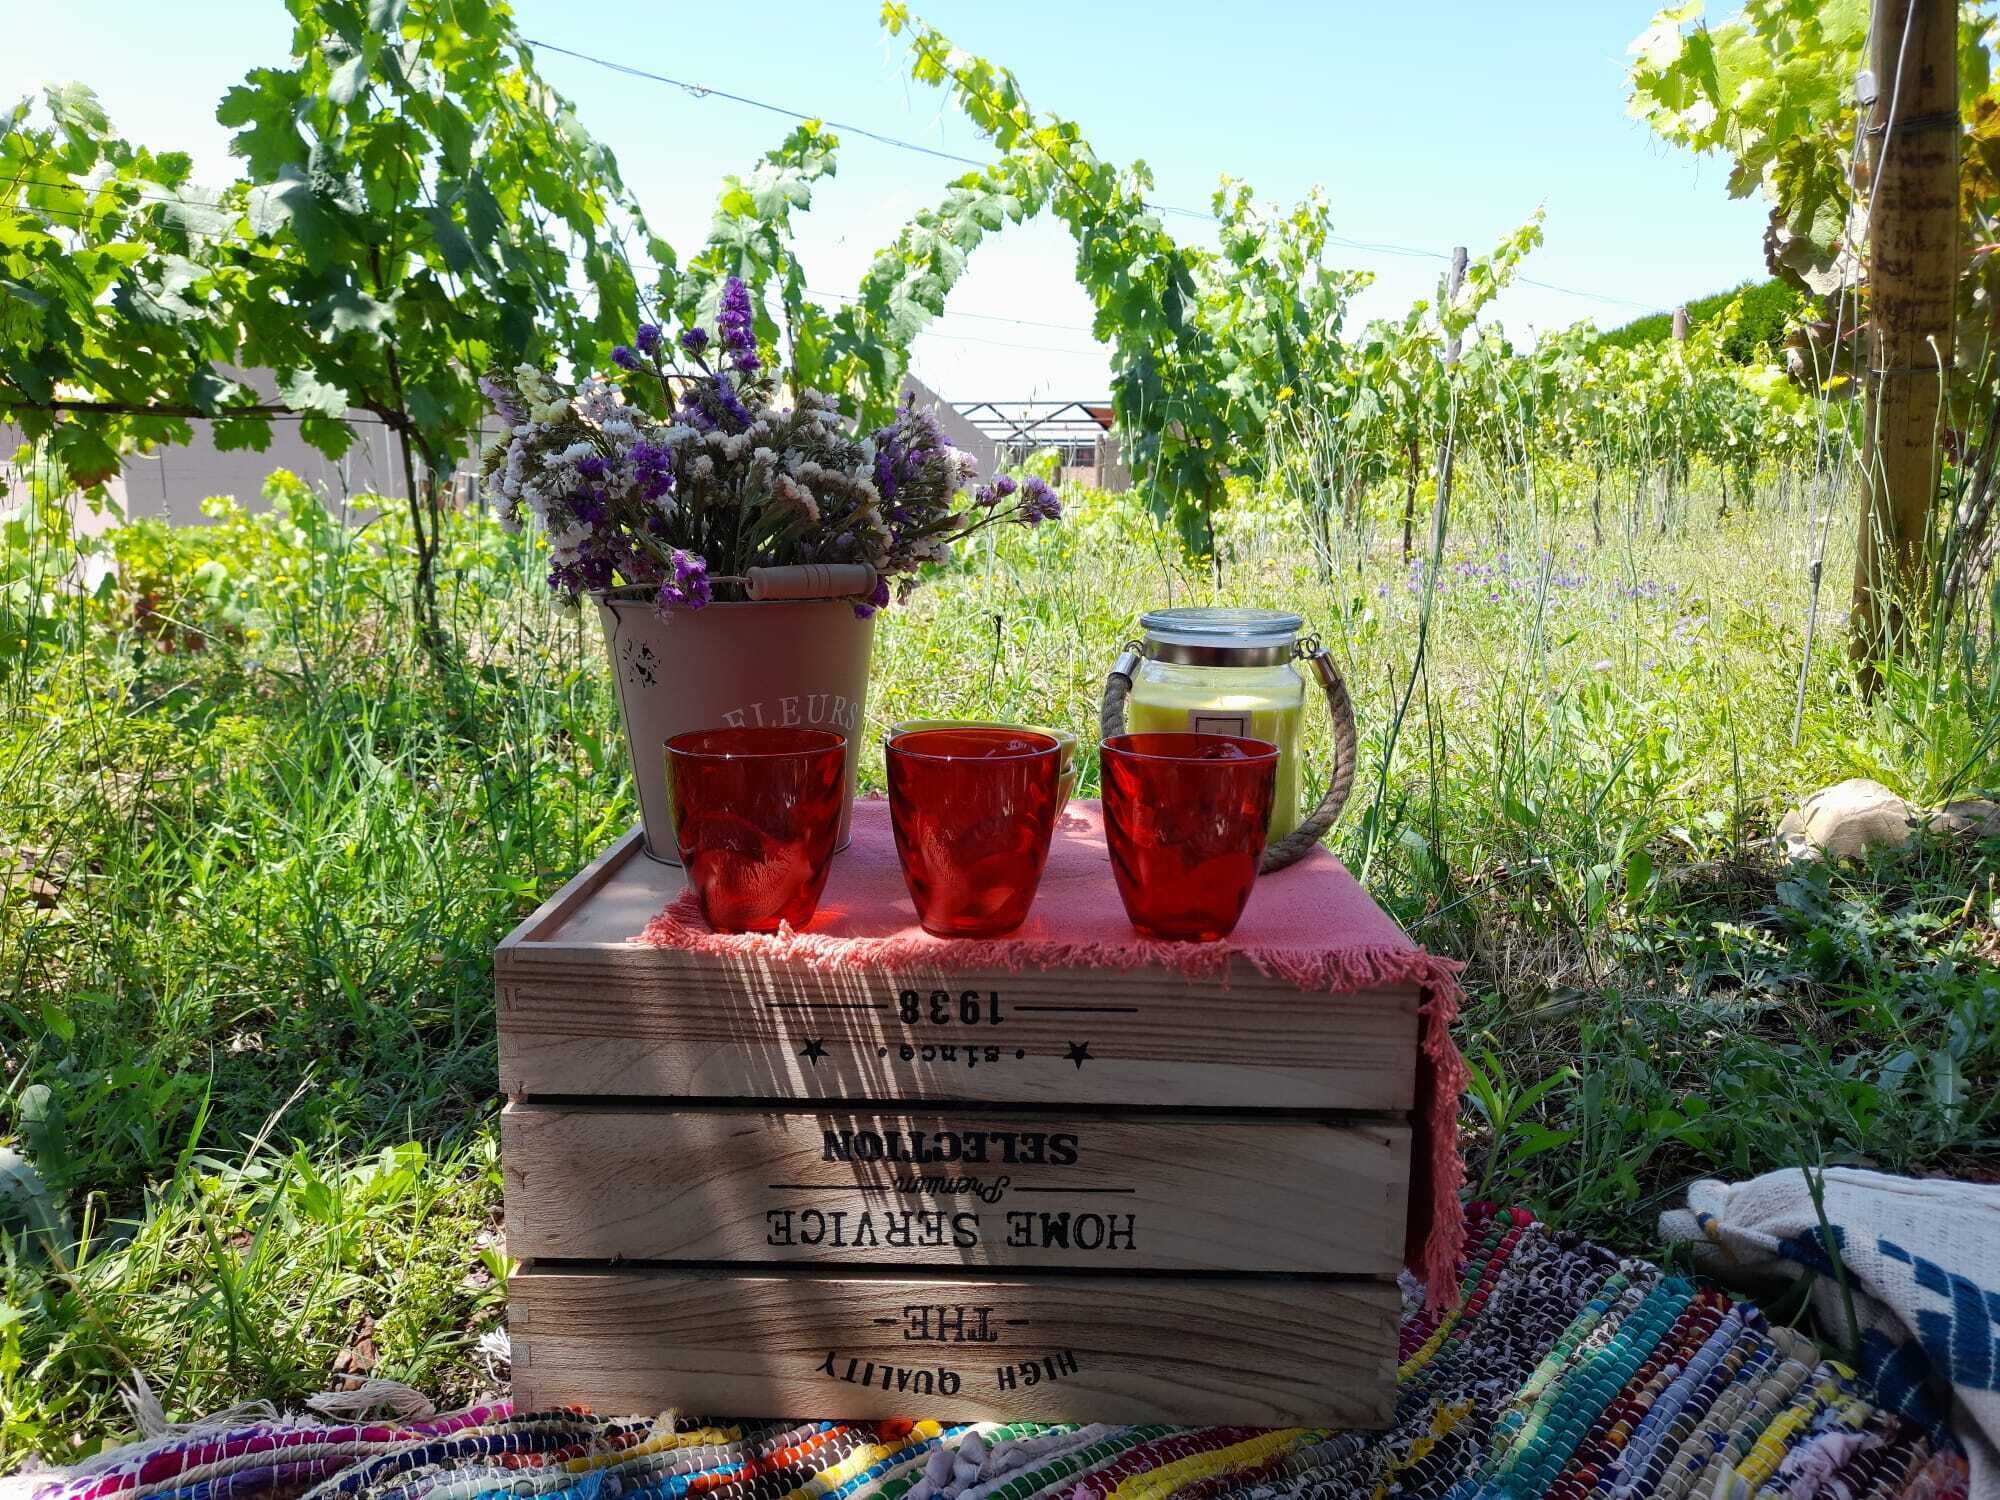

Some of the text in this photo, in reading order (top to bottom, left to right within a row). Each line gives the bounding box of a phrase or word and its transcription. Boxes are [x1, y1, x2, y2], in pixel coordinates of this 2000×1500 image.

[721, 694, 859, 730] FLEURS
[899, 991, 1004, 1025] 1938
[822, 1131, 1078, 1164] SELECTION
[894, 1176, 1010, 1203] Premium
[766, 1210, 1136, 1250] HOME SERVICE
[903, 1306, 997, 1342] THE
[815, 1351, 1078, 1395] HIGH QUALITY
